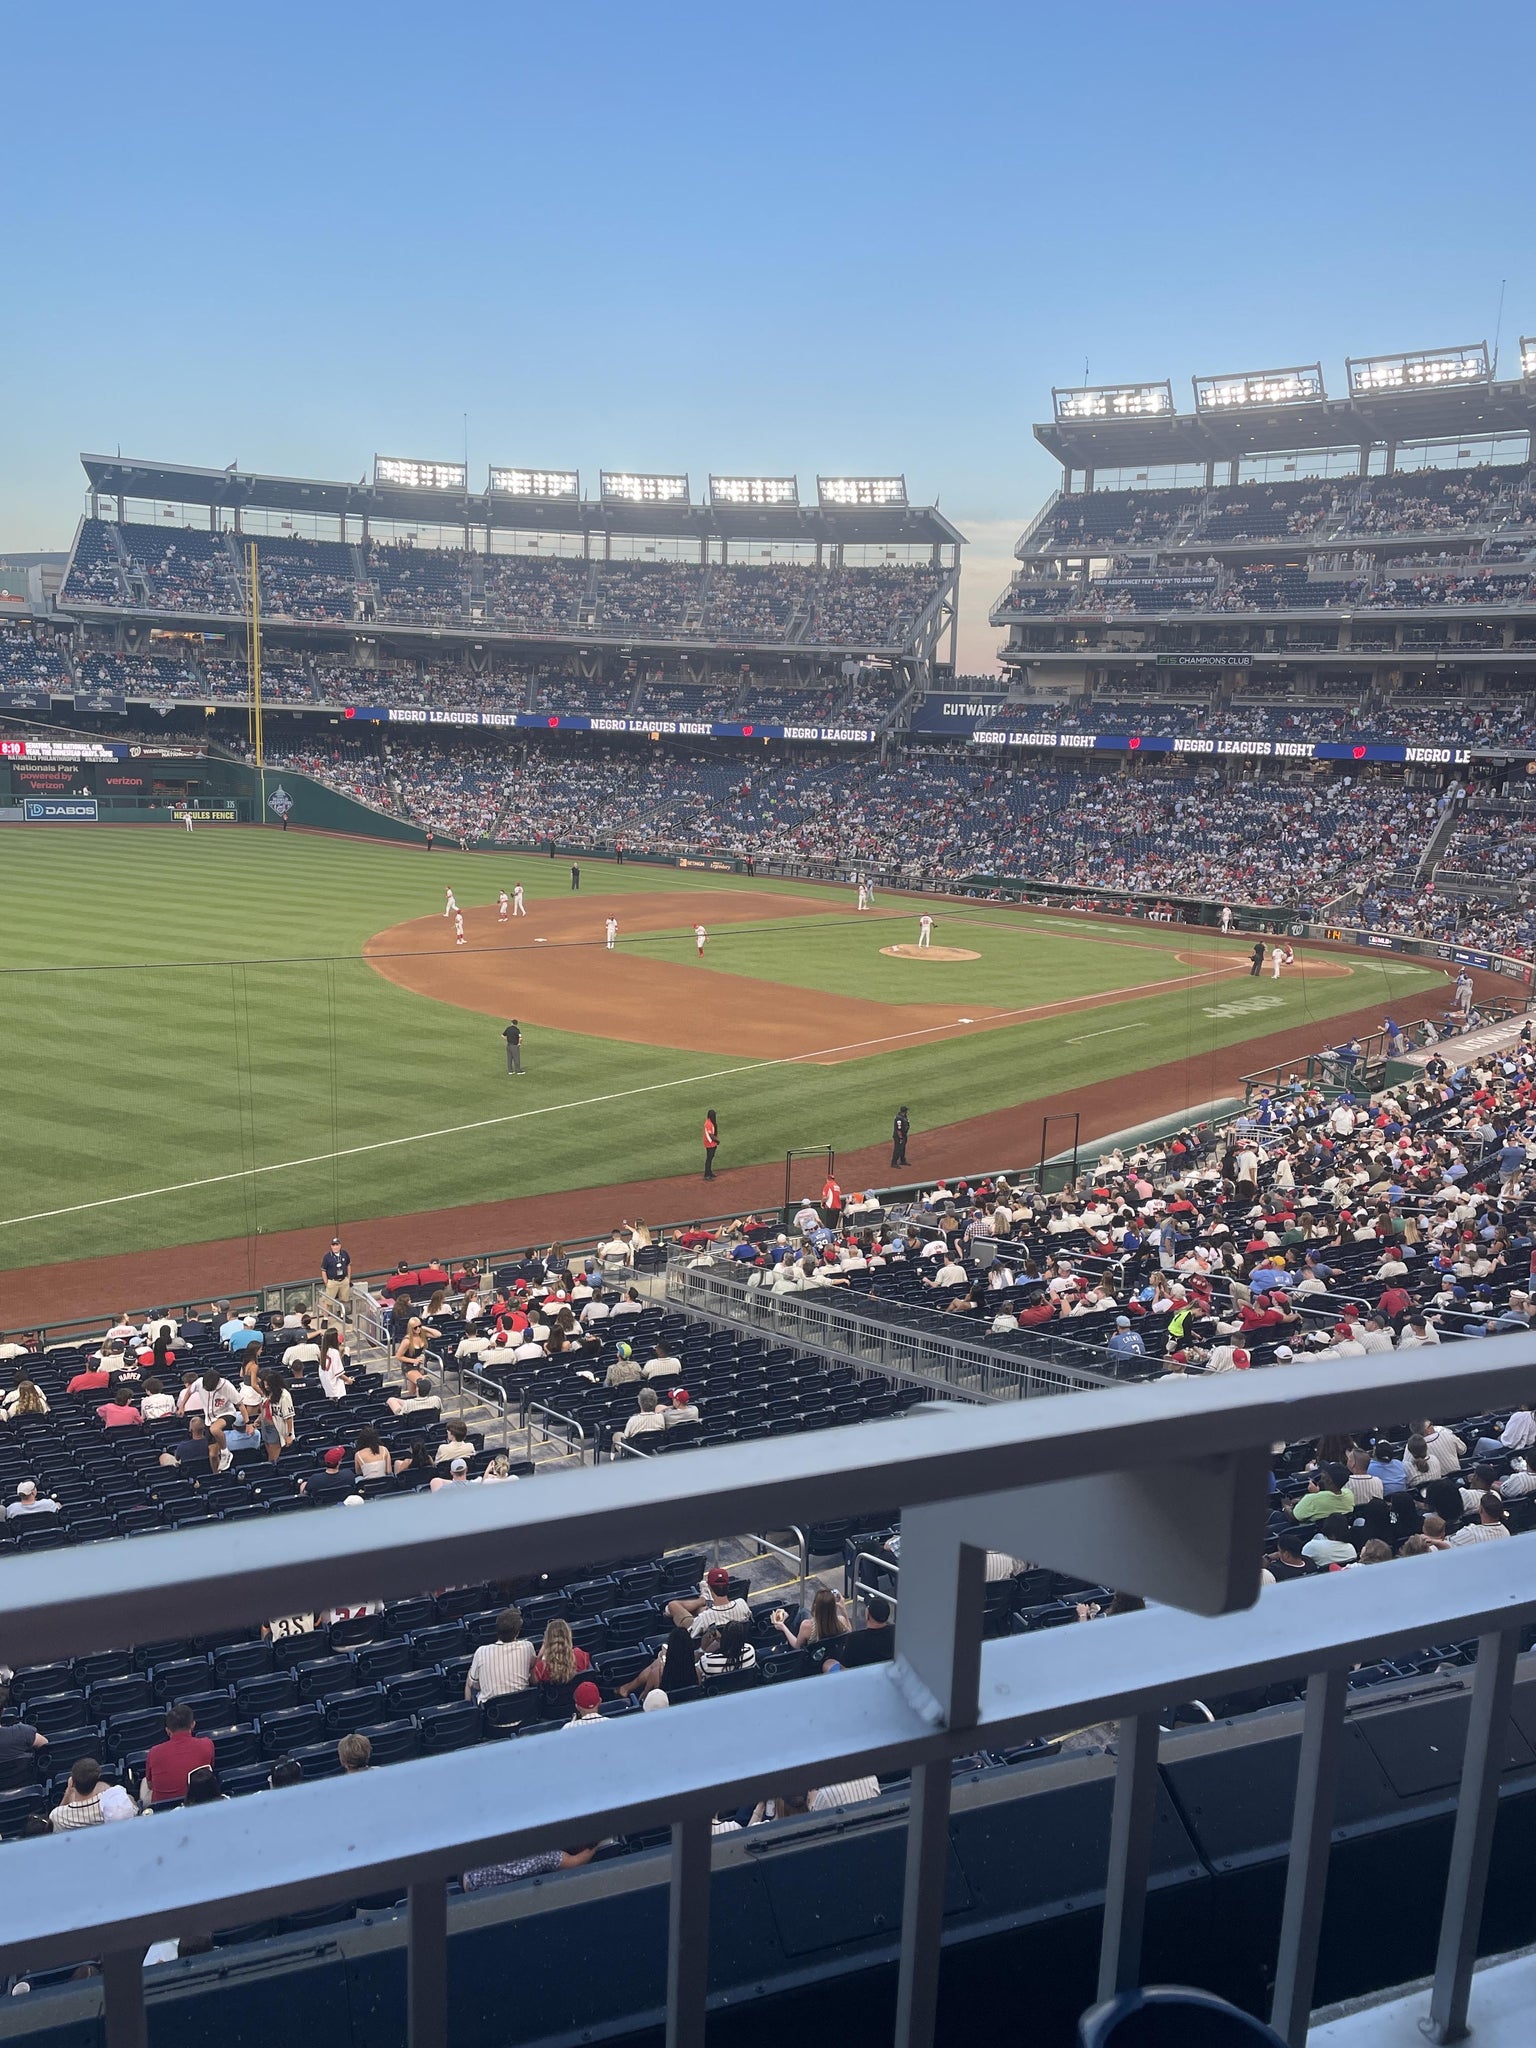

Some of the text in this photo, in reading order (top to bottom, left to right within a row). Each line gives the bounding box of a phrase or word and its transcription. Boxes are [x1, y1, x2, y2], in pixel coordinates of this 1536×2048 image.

[1179, 656, 1226, 665] CHAMPIONS
[1227, 657, 1250, 665] CLUB
[388, 709, 517, 726] NEGRO LEAGUES NIGHT
[590, 718, 712, 735] NEGRO LEAGUES NIGHT
[783, 727, 818, 739] NEGRO
[821, 729, 867, 741] LEAGUES
[973, 731, 1096, 747] NEGRO LEAGUES NIGHT
[2, 743, 20, 754] 8:10
[1174, 739, 1315, 756] NEGRO LEAGUES NIGHT
[1405, 747, 1450, 762] NEGRO
[13, 763, 79, 772] Nationals Park
[20, 772, 73, 781] powered by
[106, 776, 142, 785] verizon
[30, 781, 64, 789] Verizon
[226, 800, 235, 809] 335
[45, 806, 95, 815] DABOS
[212, 811, 235, 820] FENCE
[118, 1372, 142, 1382] HARPER
